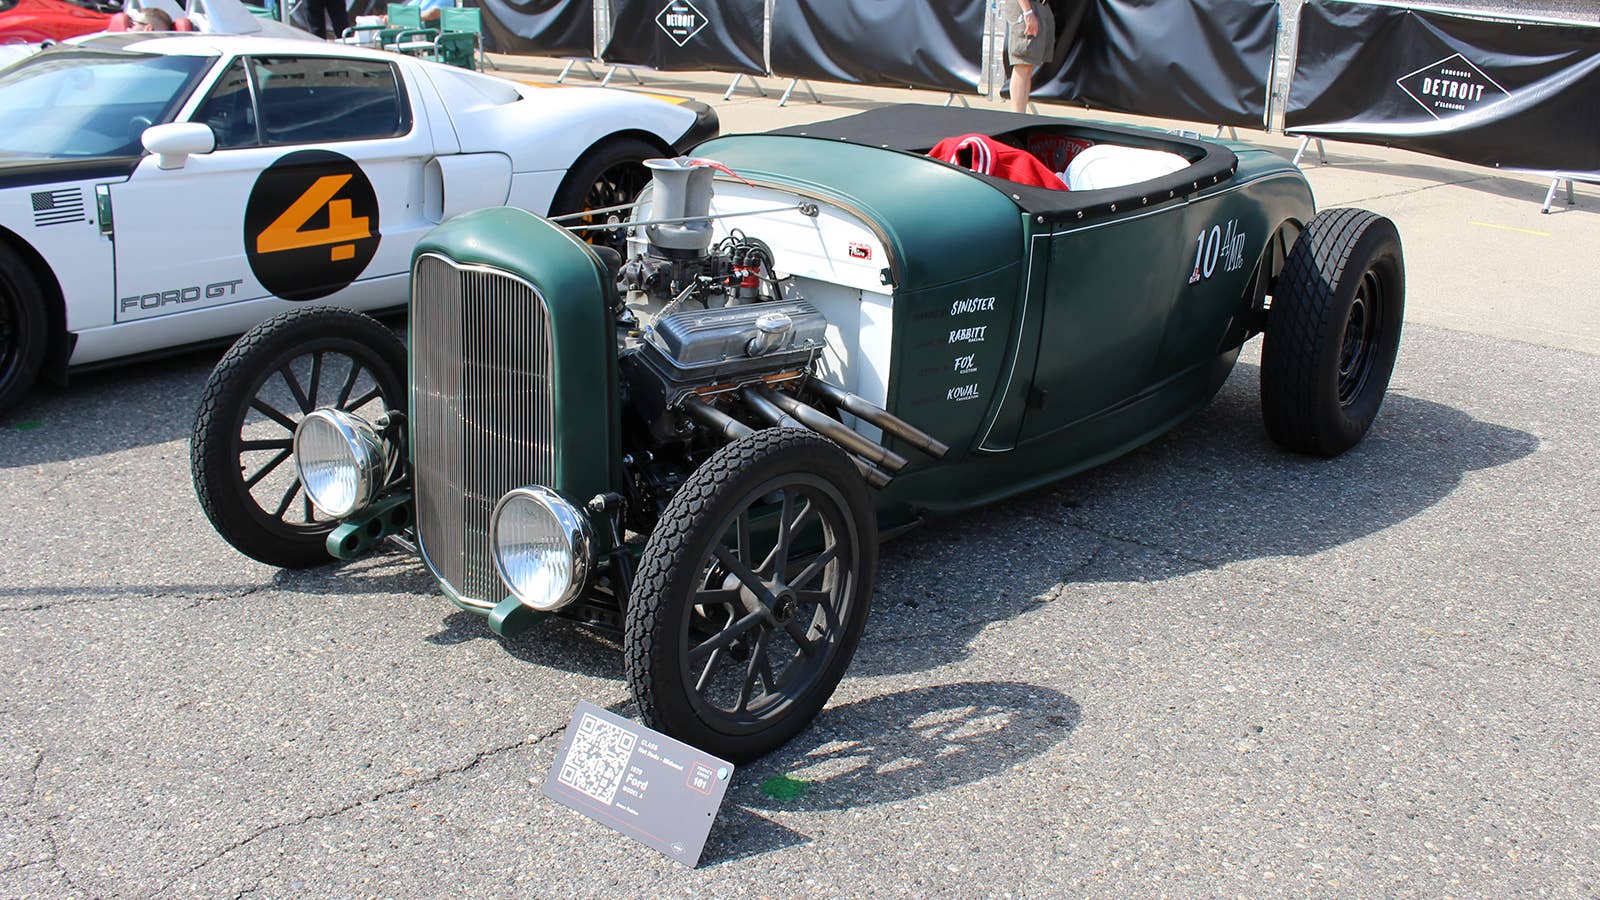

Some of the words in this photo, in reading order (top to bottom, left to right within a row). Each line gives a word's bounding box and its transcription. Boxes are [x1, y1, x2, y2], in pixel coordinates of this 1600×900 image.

[666, 14, 695, 27] DETROIT
[1422, 77, 1484, 101] DETROIT
[257, 173, 372, 262] 4
[1189, 224, 1220, 284] 10
[120, 286, 201, 313] FORD
[205, 279, 243, 299] GT
[950, 296, 995, 316] SINISTER
[948, 325, 987, 344] RABBITT
[954, 353, 975, 371] FOX
[946, 383, 979, 401] KOWAL
[640, 739, 659, 751] CLASS
[625, 773, 649, 791] Ford
[693, 776, 708, 790] 101
